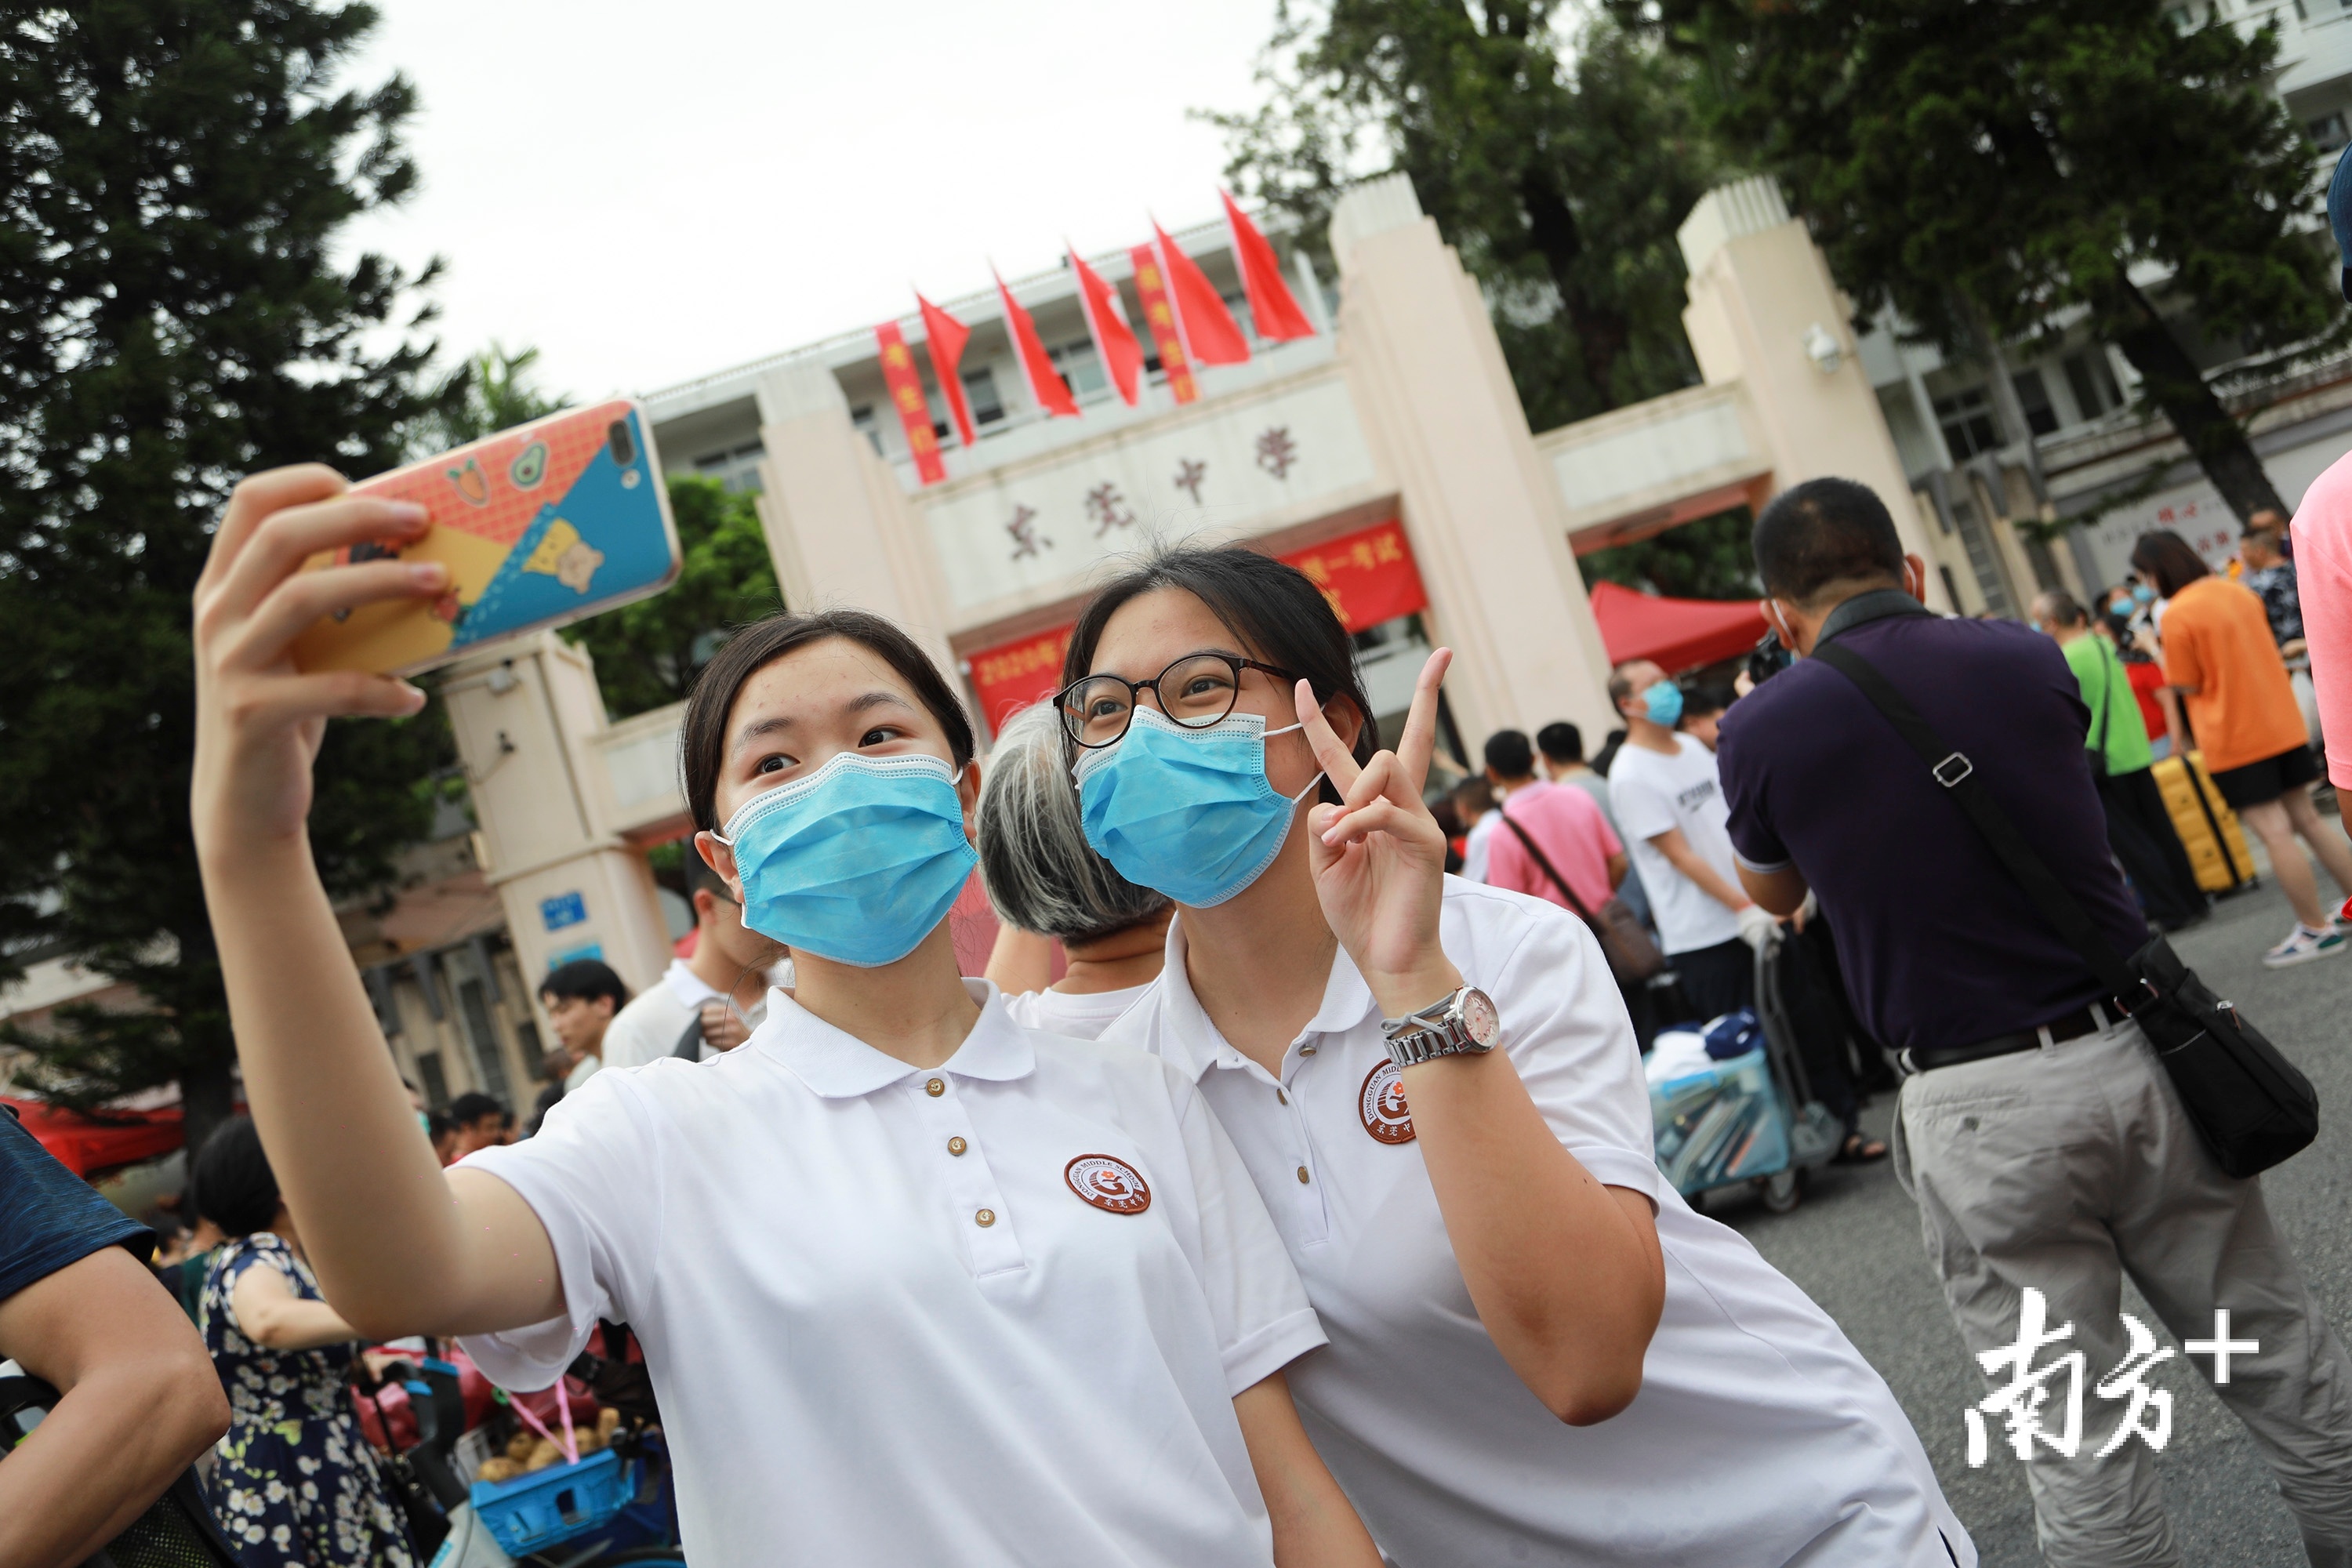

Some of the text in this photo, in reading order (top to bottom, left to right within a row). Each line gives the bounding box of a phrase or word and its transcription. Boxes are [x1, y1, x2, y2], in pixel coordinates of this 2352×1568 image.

[1365, 1073, 1381, 1120] DONGGUAN
[1073, 1160, 1141, 1197] DONGGUAN MIDDLE SCHOOL
